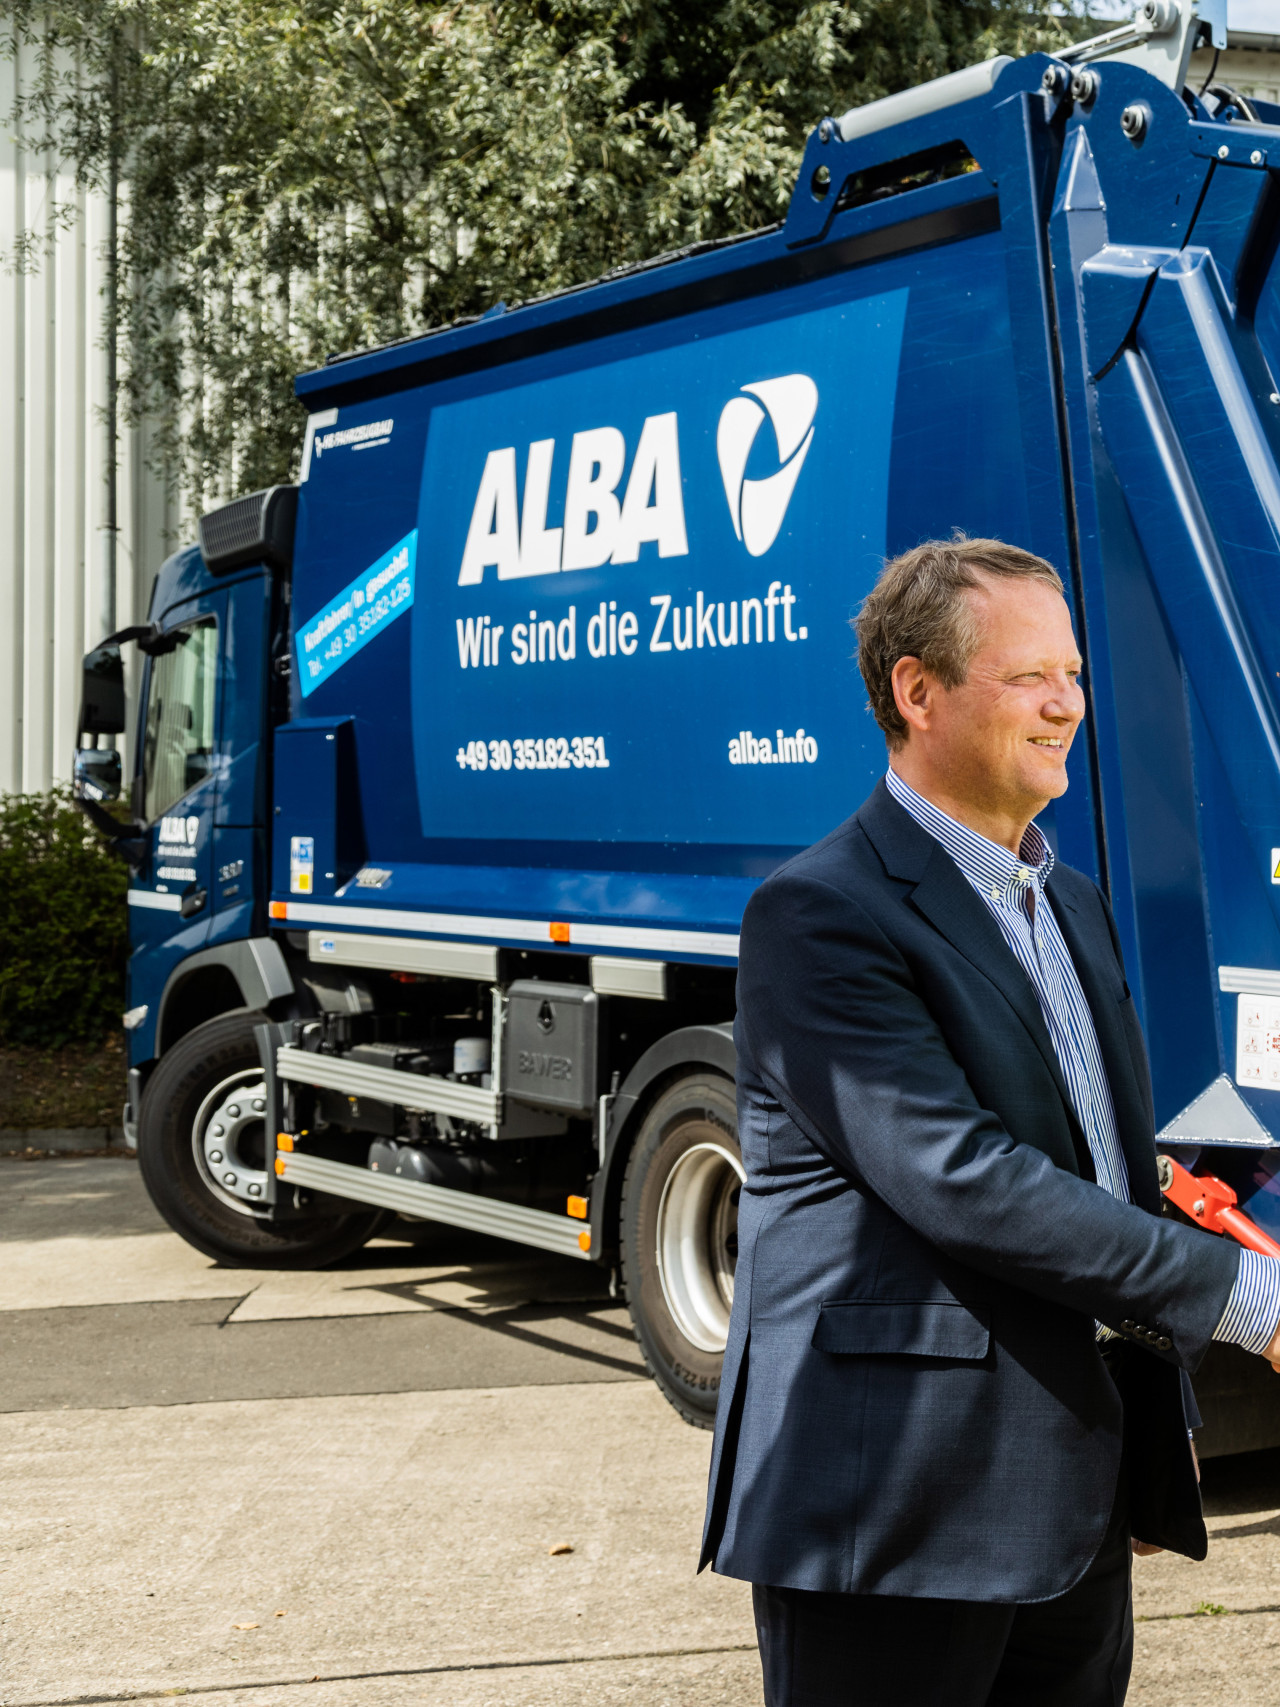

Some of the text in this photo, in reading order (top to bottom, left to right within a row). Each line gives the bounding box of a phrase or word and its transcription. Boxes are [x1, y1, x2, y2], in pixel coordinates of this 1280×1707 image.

[458, 411, 690, 586] ALBA
[456, 581, 808, 669] Wir sind die Zukunft.
[456, 736, 610, 771] +49 30 35182-351
[728, 729, 819, 765] alba.info
[519, 1051, 572, 1081] BAWER
